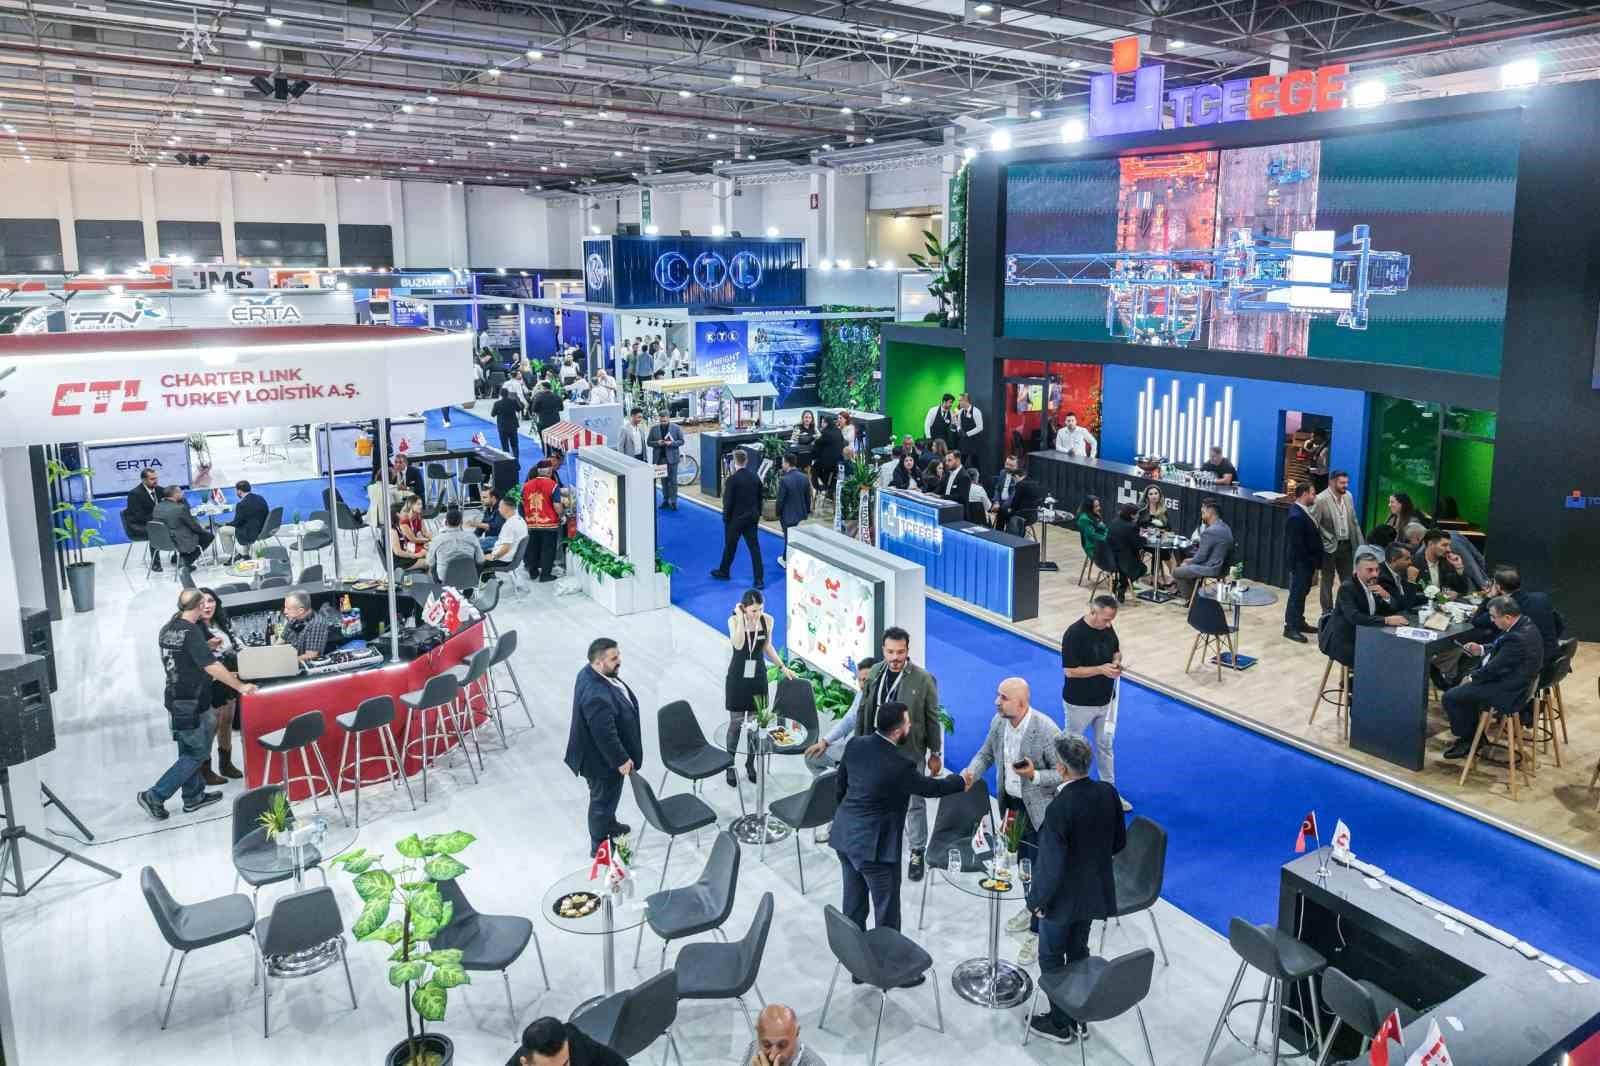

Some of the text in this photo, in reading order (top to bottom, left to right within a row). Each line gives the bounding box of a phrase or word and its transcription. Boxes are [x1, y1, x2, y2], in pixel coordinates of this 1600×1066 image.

[231, 305, 301, 321] ERTA
[160, 368, 303, 388] CHARTER LINK
[51, 380, 148, 416] CTL
[161, 383, 360, 408] TURKEY LOJİSTİK A.Ş.
[116, 458, 162, 470] ERTA
